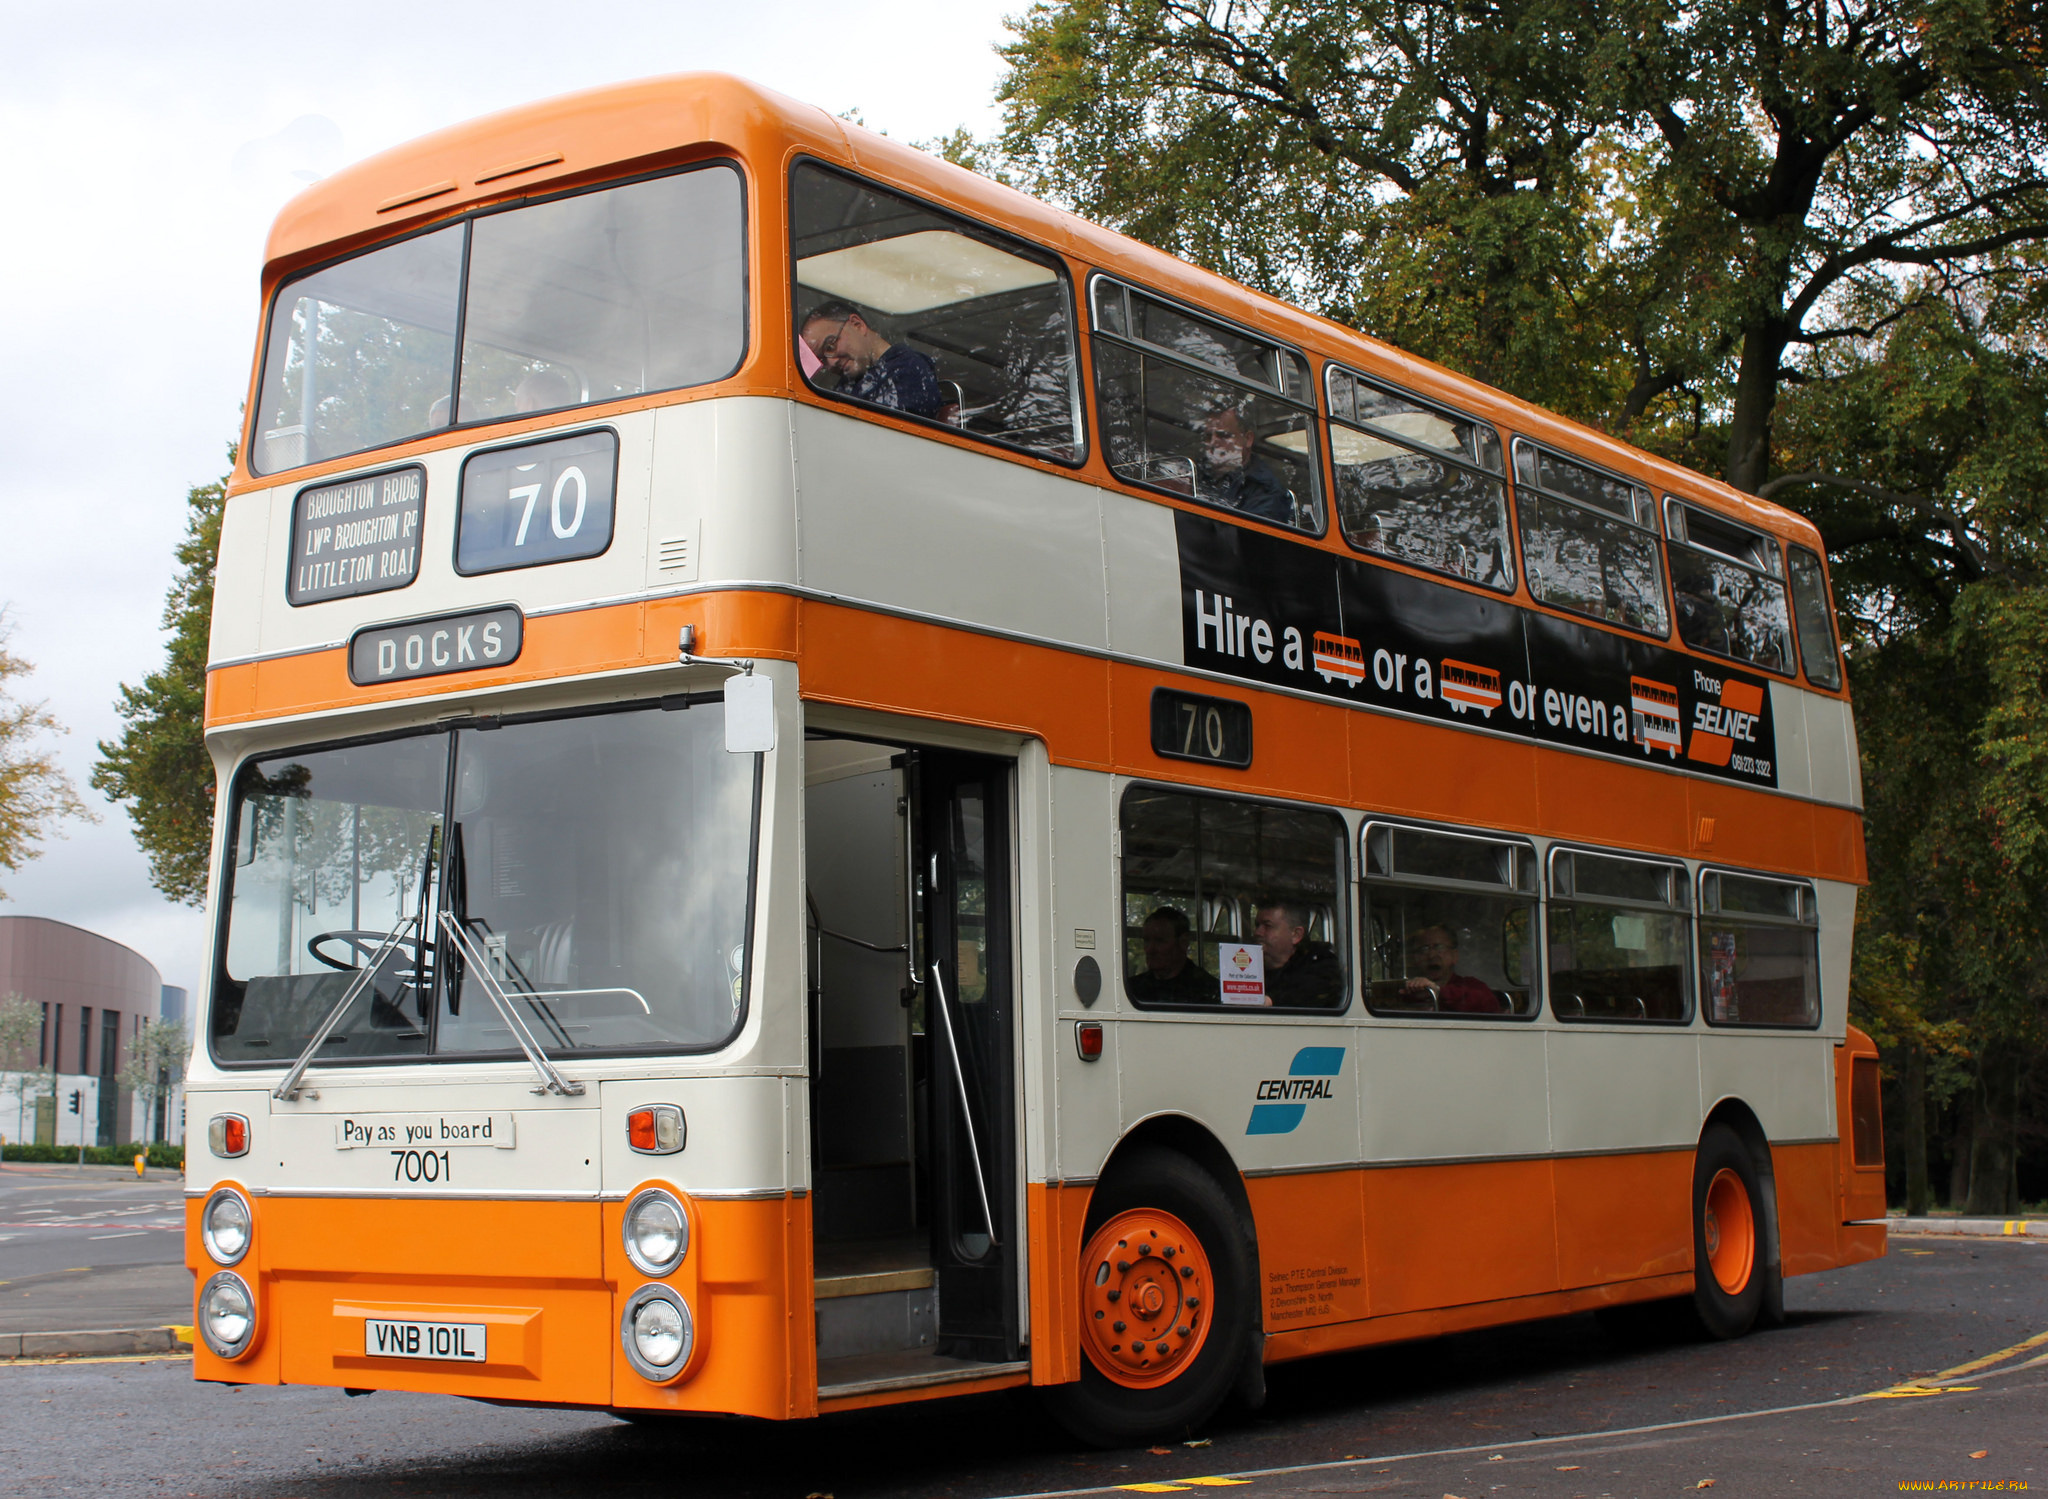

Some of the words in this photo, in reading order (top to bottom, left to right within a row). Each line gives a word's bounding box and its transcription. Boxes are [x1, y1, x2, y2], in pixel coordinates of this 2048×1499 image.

[307, 482, 375, 520] BROUGHTON
[382, 474, 419, 506] BRIDG
[509, 466, 587, 547] 70
[306, 526, 332, 556] LWR
[334, 513, 399, 551] BROUGHTON
[298, 554, 374, 592] LITTLETON
[378, 621, 502, 676] DOCKS
[1195, 589, 1274, 664] Hire
[1283, 626, 1304, 671] a
[1373, 648, 1407, 693] or
[1414, 658, 1433, 699] a
[1508, 680, 1537, 721] or
[1543, 688, 1608, 737] even
[1612, 704, 1628, 742] a
[1693, 669, 1722, 696] Phone
[1182, 703, 1222, 758] 70
[1692, 701, 1760, 743] SELNEC
[1755, 759, 1772, 778] 3322
[1256, 1079, 1333, 1101] CENTRAL
[344, 1119, 373, 1146] Pay
[377, 1125, 396, 1141] as
[406, 1125, 432, 1144] you
[440, 1117, 493, 1139] board
[390, 1150, 450, 1182] 7001
[1270, 1310, 1304, 1321] Manchester
[375, 1323, 420, 1354] VNB
[428, 1327, 476, 1357] 101L
